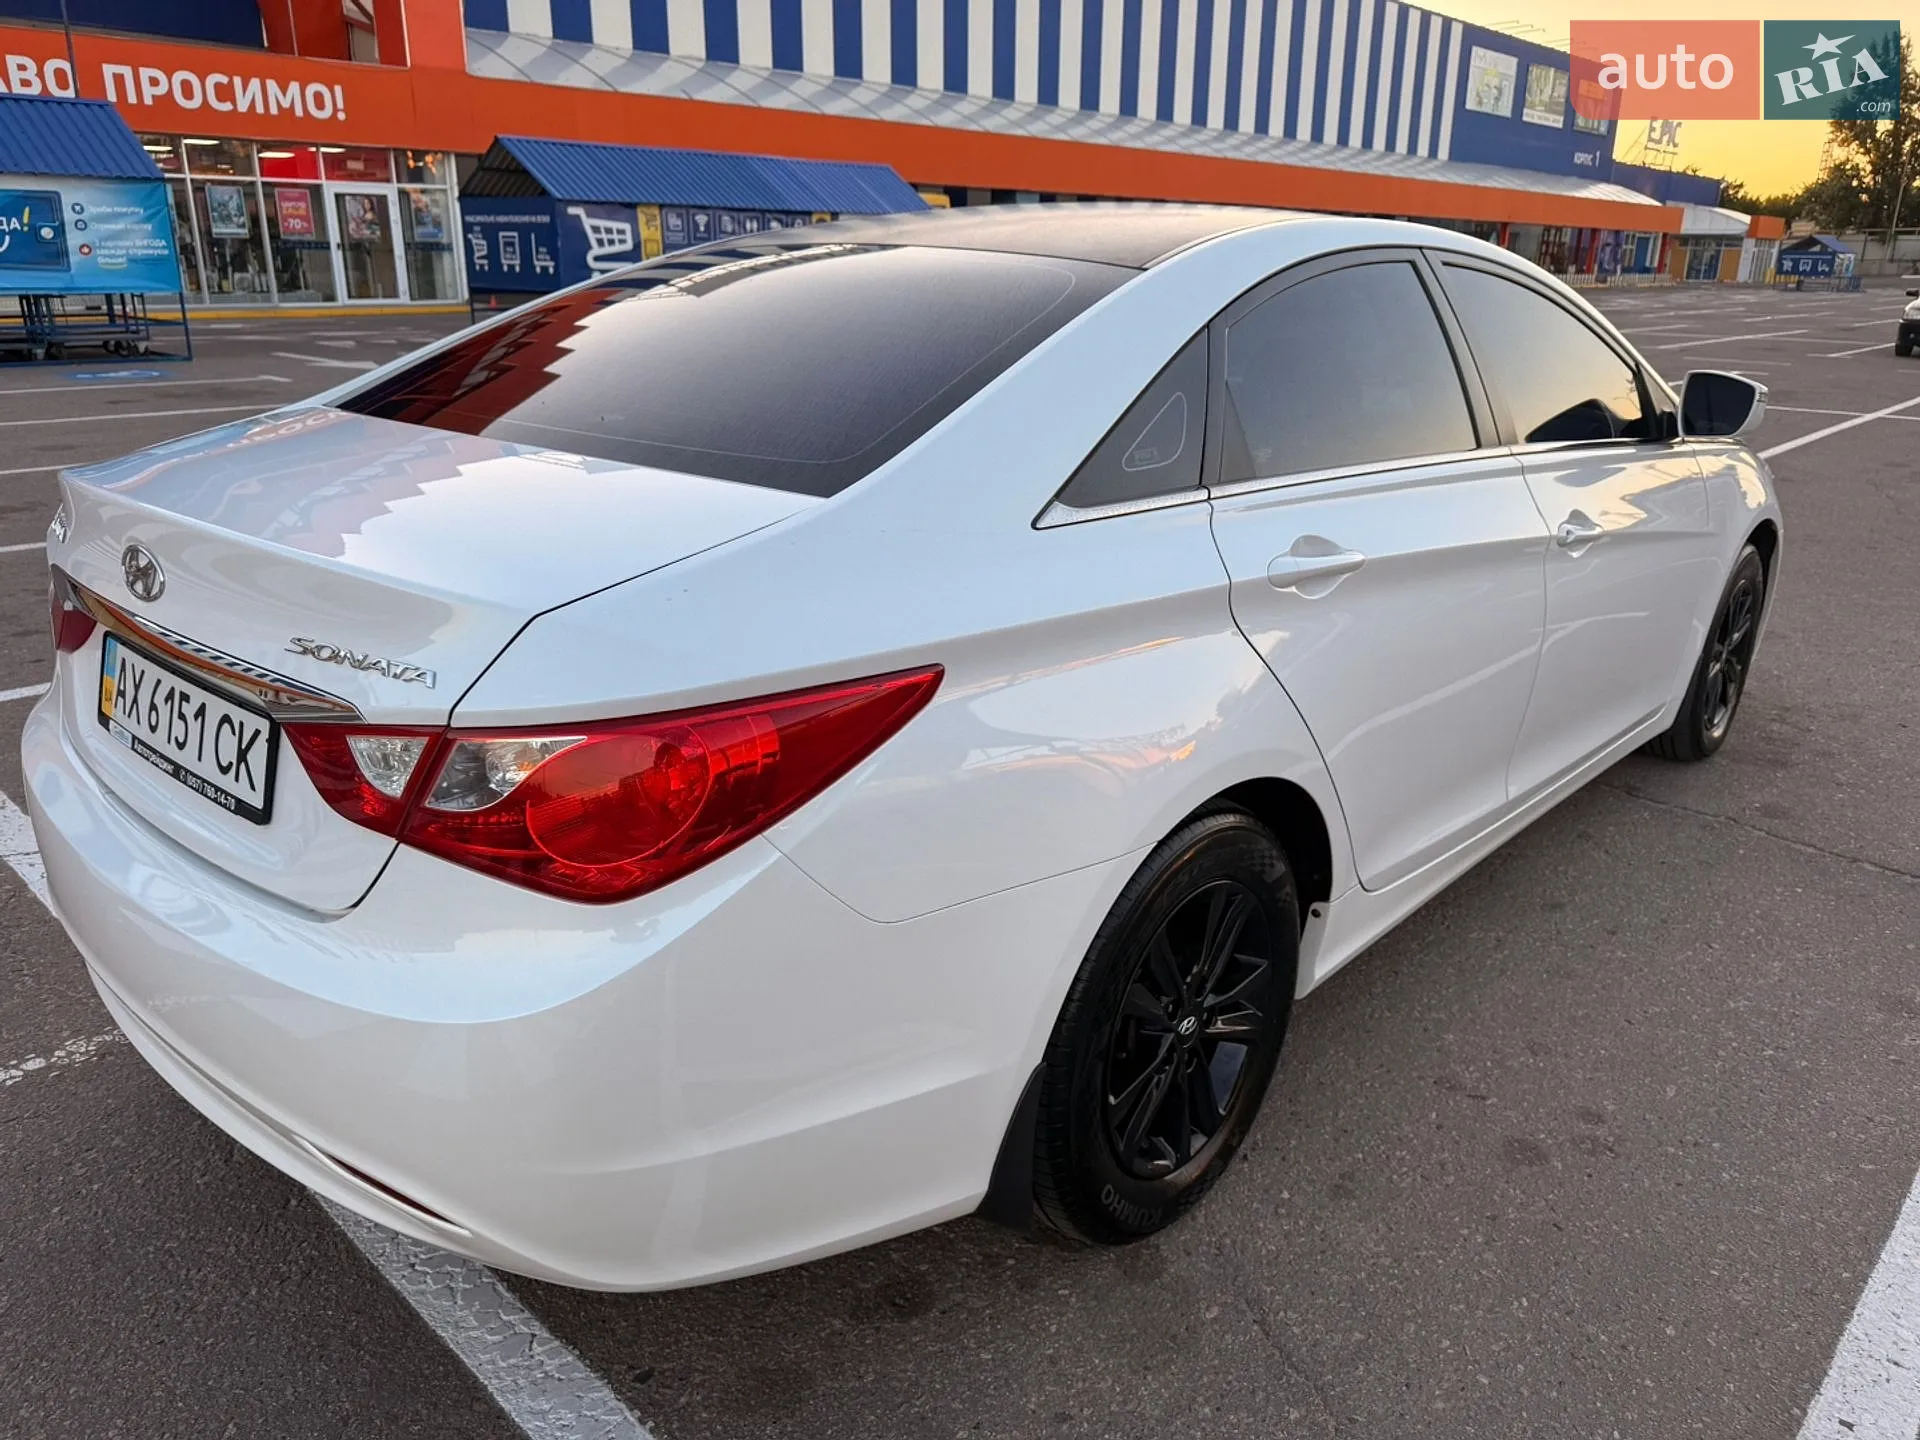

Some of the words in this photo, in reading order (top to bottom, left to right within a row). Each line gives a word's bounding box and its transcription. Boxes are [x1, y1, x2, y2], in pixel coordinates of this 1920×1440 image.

[0, 54, 76, 97] ВО
[102, 63, 346, 121] ПРОСИМО!
[284, 637, 437, 689] SONATA
[114, 657, 146, 726] AX
[148, 678, 207, 763] 6151
[214, 713, 262, 793] CK
[1101, 1183, 1163, 1225] KUMHO
